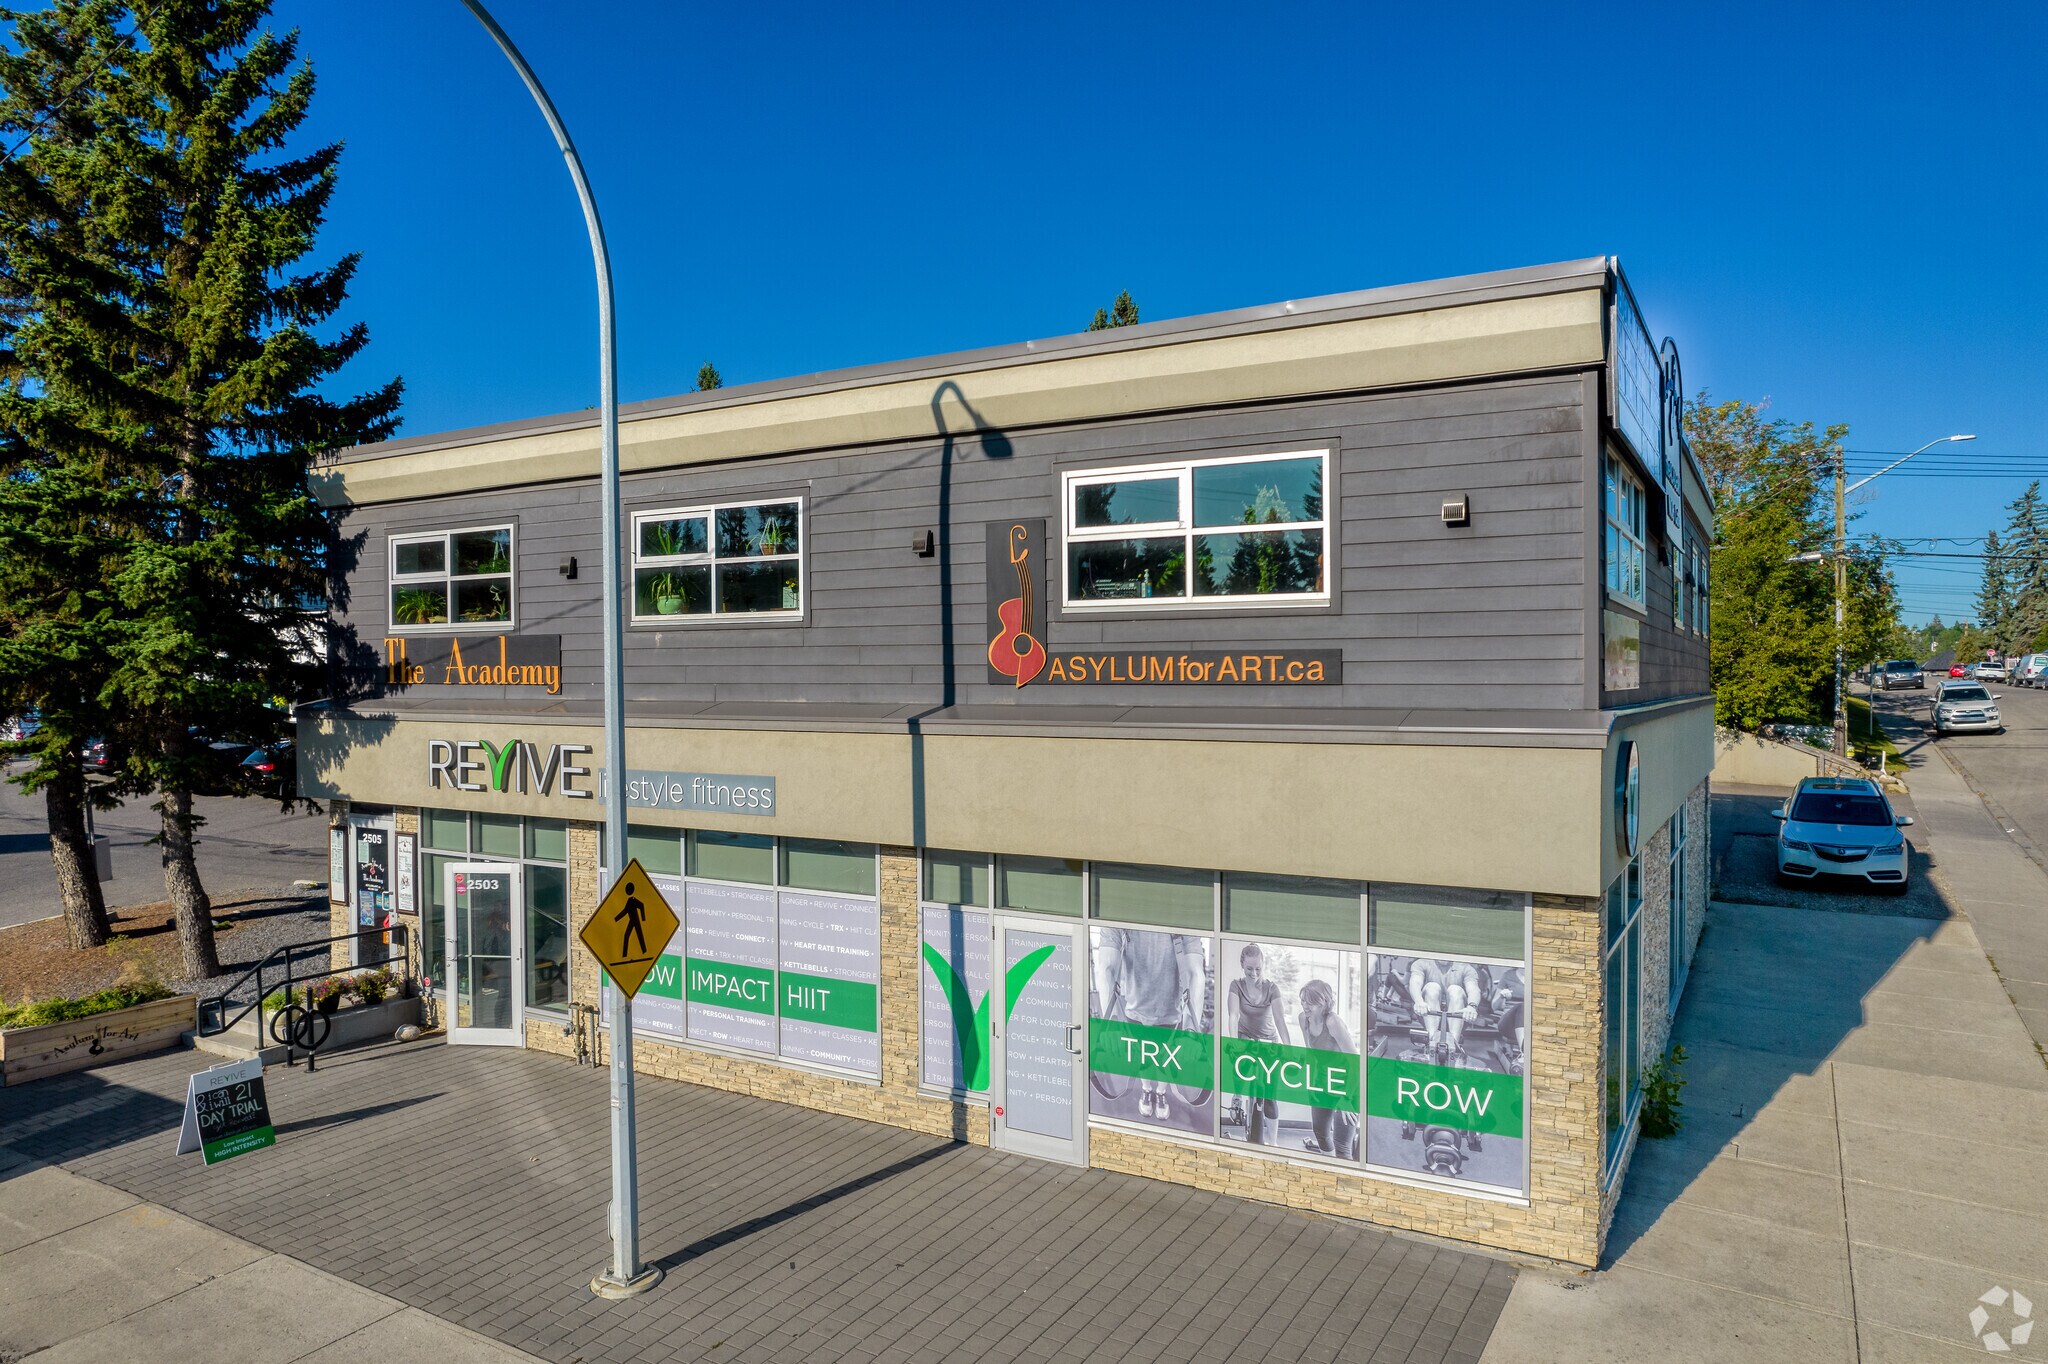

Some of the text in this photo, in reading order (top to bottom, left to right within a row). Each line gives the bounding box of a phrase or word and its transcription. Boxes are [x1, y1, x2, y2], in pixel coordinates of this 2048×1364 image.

[385, 635, 560, 694] The Academy
[429, 739, 592, 798] REVIVE
[598, 770, 773, 811] listyle fitness
[362, 833, 382, 845] 2505
[466, 879, 499, 890] 2503
[731, 891, 765, 902] STRONGER
[781, 897, 808, 906] LONGER
[814, 901, 838, 910] REVIVE
[690, 906, 726, 917] COMMUNITY
[732, 912, 764, 922] PERSONAL
[803, 920, 824, 930] CYCLE
[830, 924, 844, 932] TRX
[708, 930, 730, 938] REVIVE
[736, 934, 766, 943] CONNECT
[794, 941, 816, 950] HEART
[818, 944, 835, 952] RATE
[836, 946, 870, 957] TRAINING
[694, 948, 714, 956] CYCLE
[784, 960, 828, 972] KETTLEBELLS
[834, 968, 870, 978] STRONGER
[644, 964, 830, 1011] OW IMPACT HIIT
[702, 1010, 734, 1020] PERSONAL
[736, 1014, 766, 1026] TRAINING
[800, 1026, 812, 1034] TRX
[832, 1032, 862, 1043] CLASSES
[1022, 1016, 1038, 1024] FOR
[54, 1026, 139, 1058] Asylum for Art
[652, 1020, 673, 1030] REVIVE
[712, 1031, 728, 1040] ROW
[734, 1034, 754, 1045] HEART
[755, 1038, 772, 1048] RATE
[810, 1050, 852, 1062] COMMUNITY
[1042, 1037, 1057, 1046] TRX
[1008, 1050, 1026, 1060] ROW
[210, 1070, 247, 1086] REVIVE
[1120, 1036, 1494, 1117] TRX CYCLE ROW
[212, 1089, 229, 1100] can
[214, 1096, 231, 1108] will
[235, 1082, 252, 1101] 21
[200, 1108, 225, 1128] DAY
[228, 1098, 263, 1118] TRIAL
[214, 1137, 266, 1158] HIGH INTENSITY
[223, 1134, 254, 1148] Low Impact
